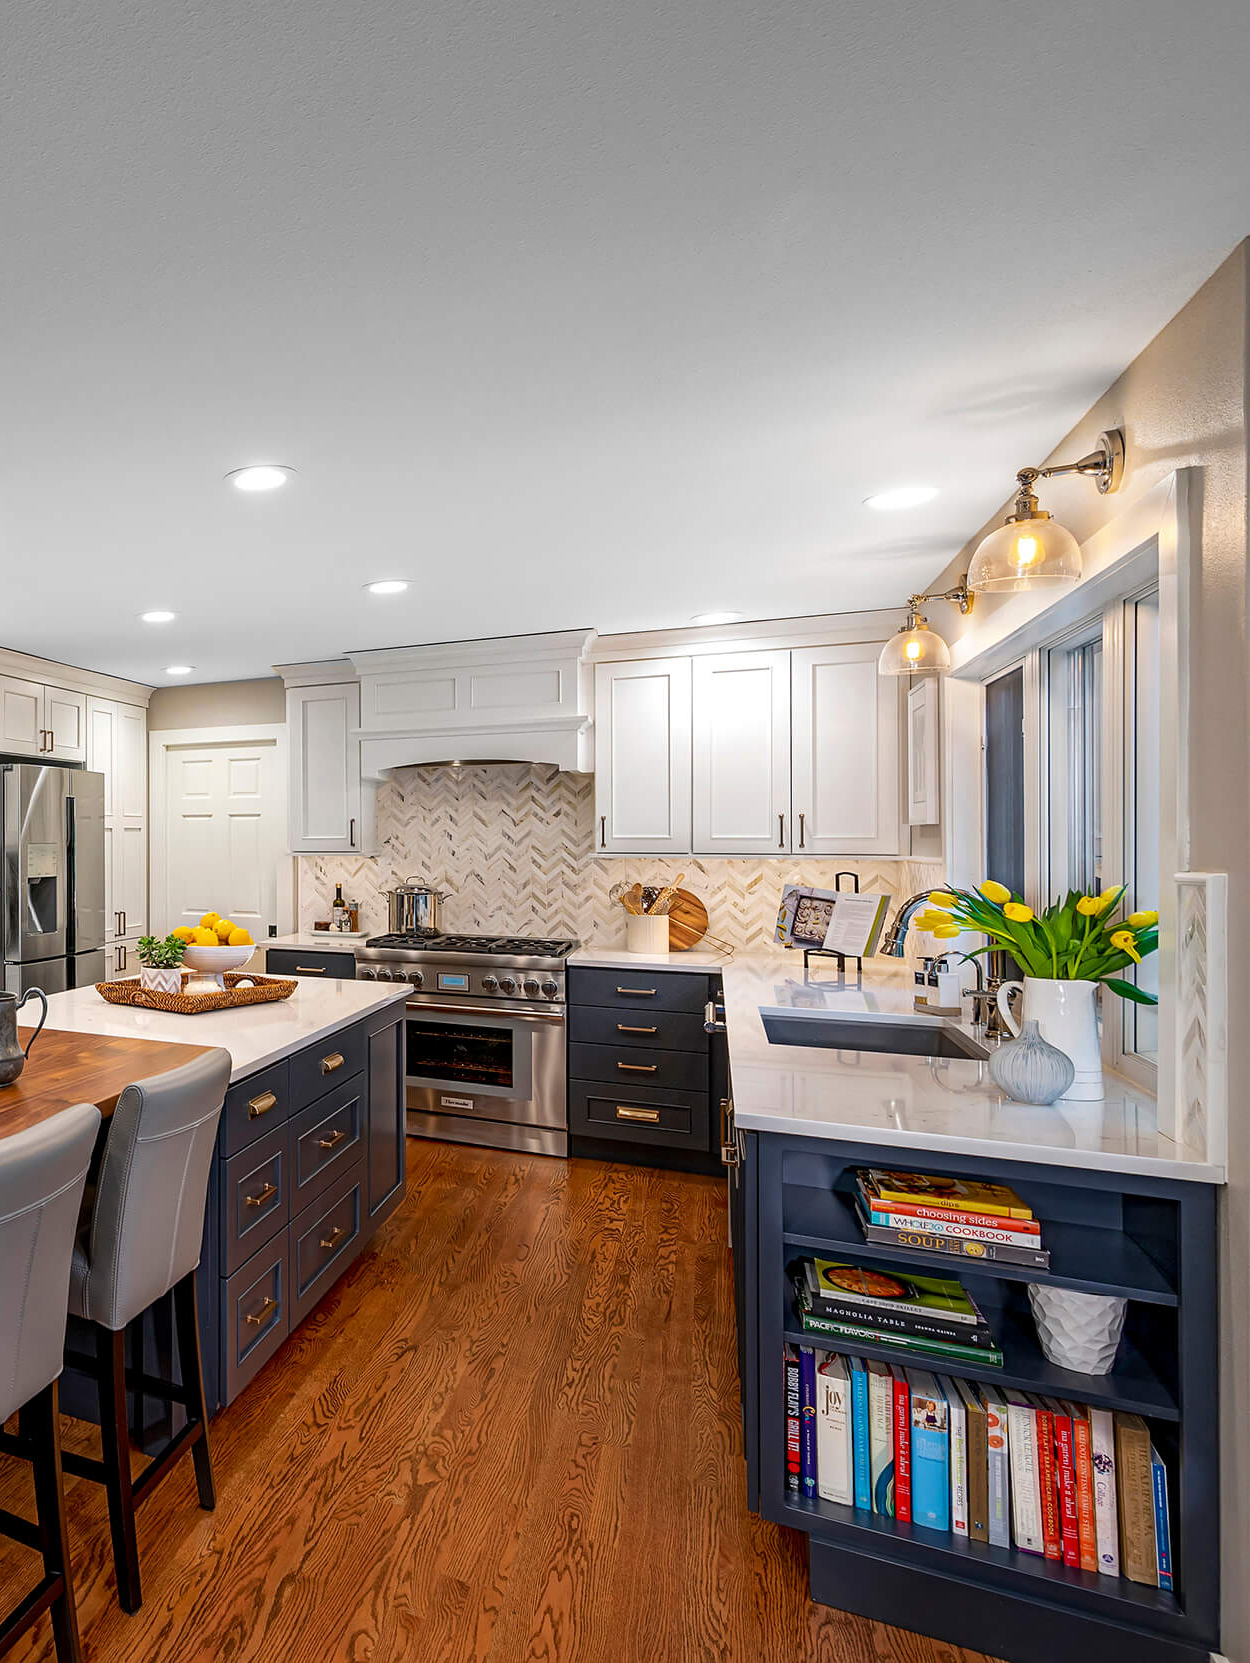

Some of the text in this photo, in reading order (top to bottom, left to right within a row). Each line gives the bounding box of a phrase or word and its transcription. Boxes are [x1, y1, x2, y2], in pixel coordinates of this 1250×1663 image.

[940, 1199, 960, 1209] dips
[916, 1207, 999, 1227] choosing sides
[897, 1233, 945, 1249] SOUP
[945, 1225, 1013, 1243] COOKBOOK
[825, 1306, 906, 1327] MAGNOLIA TABLE
[787, 1367, 799, 1452] BOBBY FLAY'S GRILL IT!
[1059, 1442, 1071, 1465] garten
[1063, 1470, 1073, 1490] make
[1065, 1497, 1077, 1518] ahead
